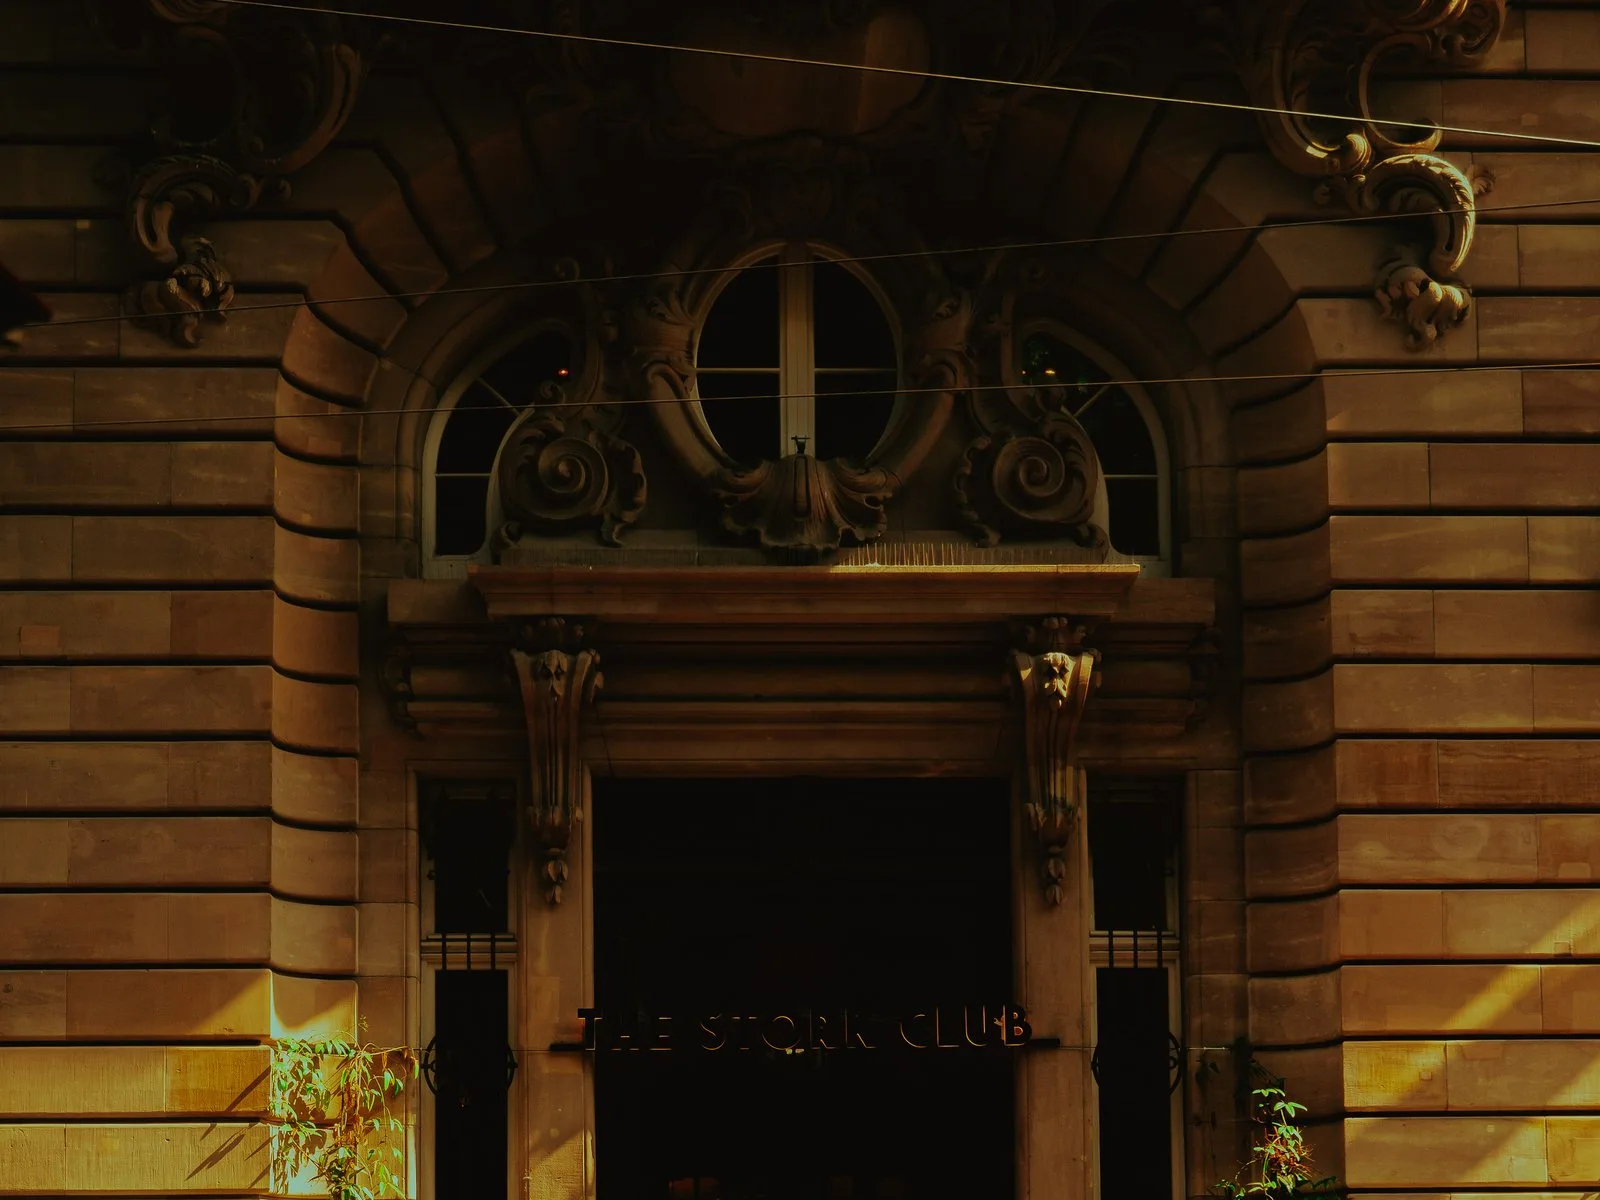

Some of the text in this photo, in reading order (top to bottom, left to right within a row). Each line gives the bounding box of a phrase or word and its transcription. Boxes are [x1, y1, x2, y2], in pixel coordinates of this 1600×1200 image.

[577, 1005, 1032, 1051] THE STORK CLUB
